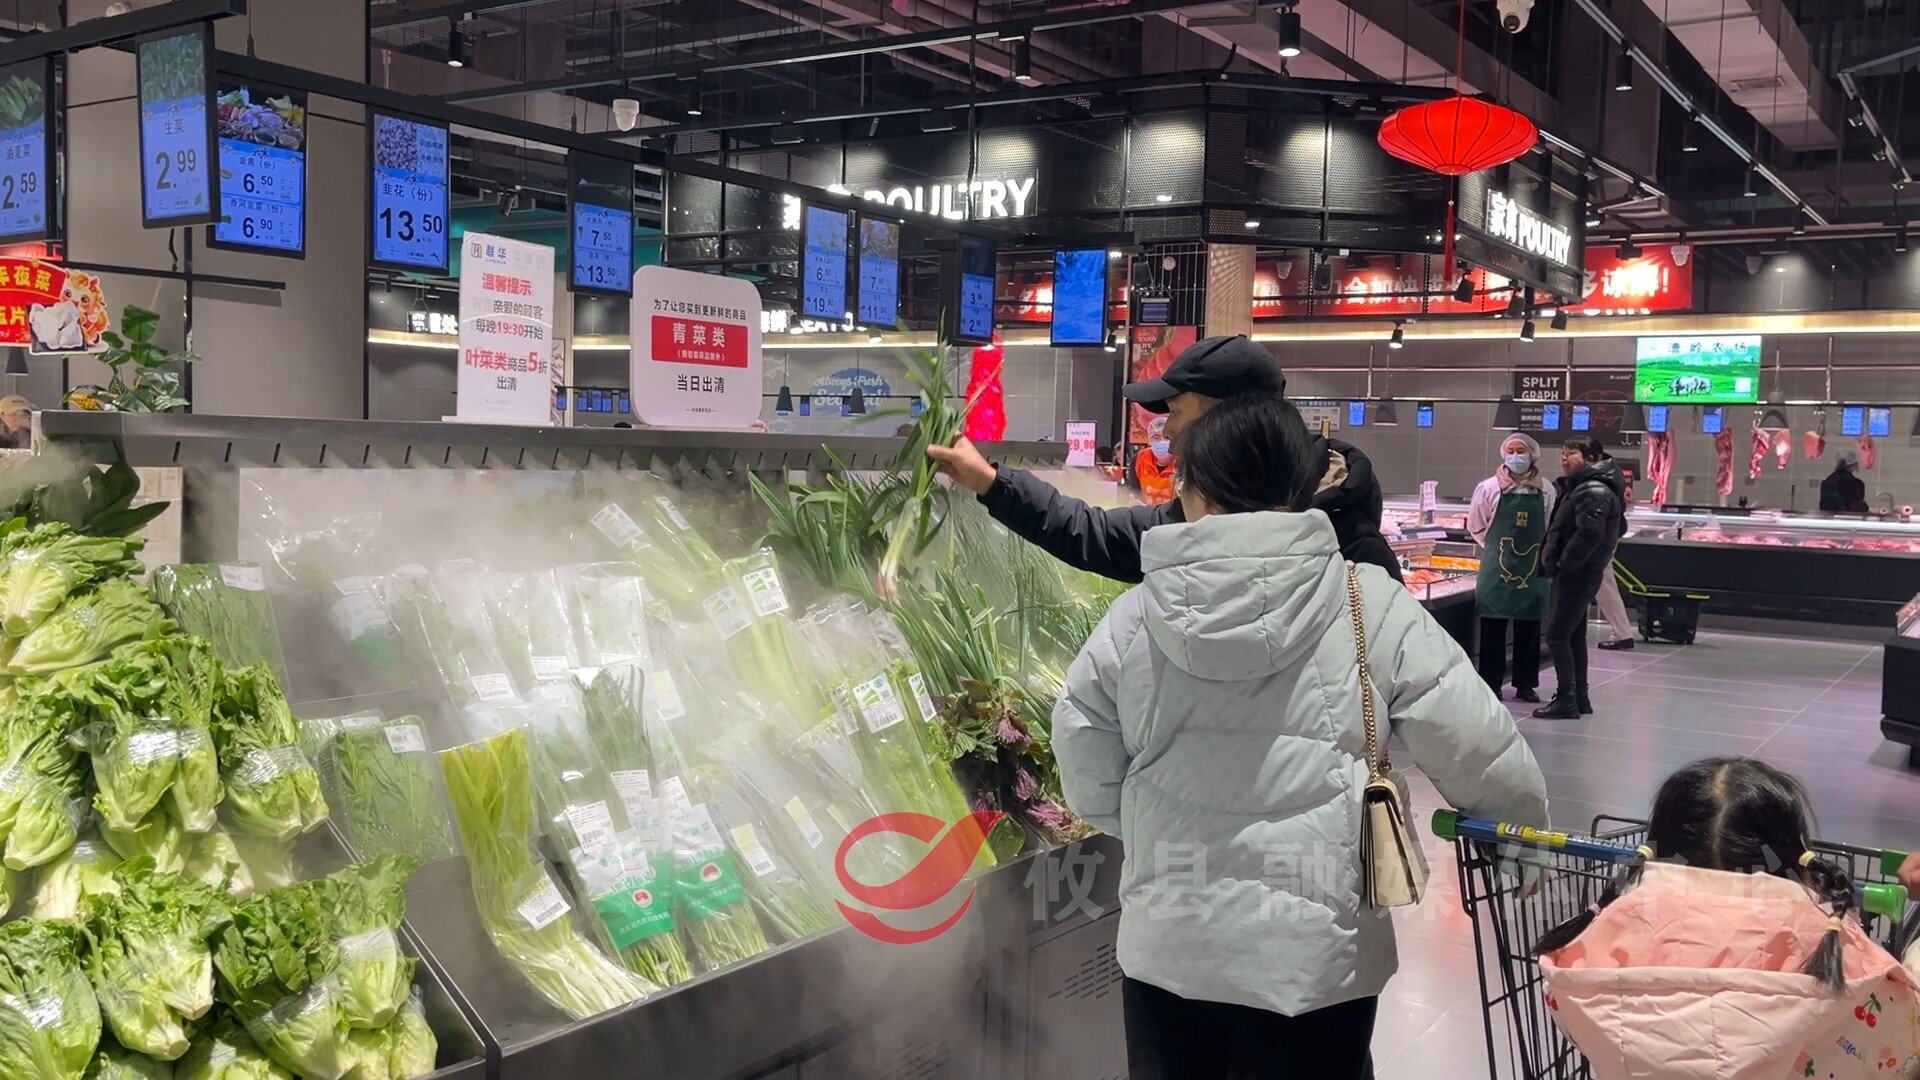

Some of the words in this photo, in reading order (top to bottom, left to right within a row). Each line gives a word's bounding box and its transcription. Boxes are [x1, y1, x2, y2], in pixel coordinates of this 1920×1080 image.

[164, 118, 185, 136] 生菜
[155, 148, 197, 190] 2.99
[2, 171, 37, 210] 2.59
[242, 172, 274, 194] 6.50
[242, 216, 273, 239] 6.90
[379, 207, 443, 242] 13.50
[591, 229, 612, 247] 7.50
[1518, 212, 1572, 265] POULTRY
[482, 272, 533, 296] 温馨提示
[587, 264, 616, 284] 13.50
[492, 300, 544, 320] 亲爱的顾客
[653, 299, 747, 321] 为了让您买到更新鲜的商品
[476, 318, 544, 340] 每晚19:30开始
[673, 322, 726, 348] 青菜类
[465, 348, 548, 375] 叶菜类商品5折
[497, 375, 517, 391] 出清
[677, 373, 725, 393] 当日出清
[814, 375, 852, 390] Always
[856, 375, 885, 387] Fresh
[1522, 376, 1560, 388] SPLIT
[1521, 389, 1559, 400] GRAPH
